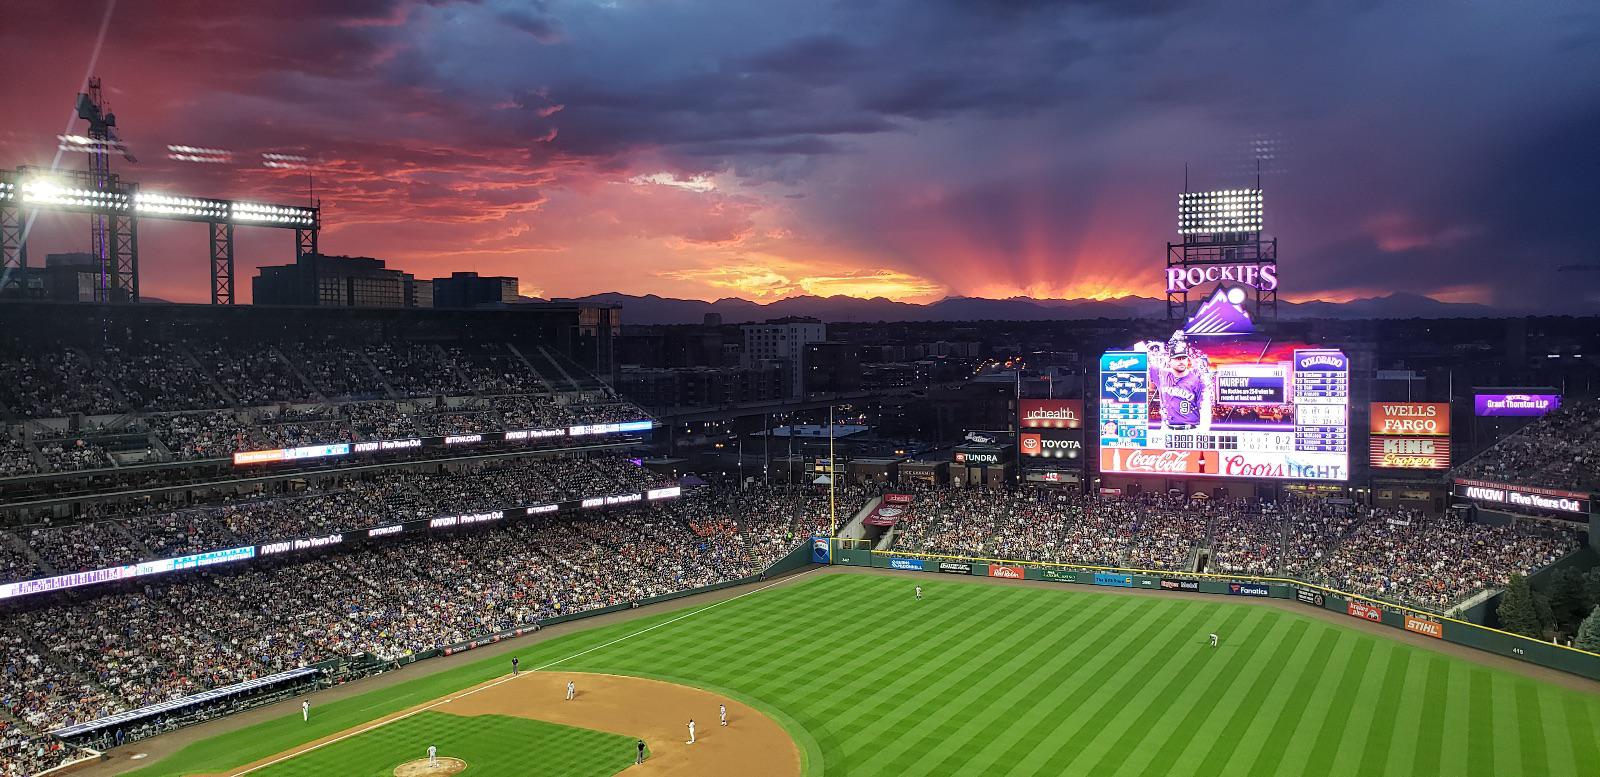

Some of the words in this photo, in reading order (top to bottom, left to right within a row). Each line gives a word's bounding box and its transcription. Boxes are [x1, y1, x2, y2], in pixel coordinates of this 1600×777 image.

[1165, 264, 1277, 292] ROCKIES
[1300, 354, 1342, 367] COLORADO
[1220, 377, 1248, 388] MURPHY
[1180, 400, 1190, 414] 9
[1488, 400, 1505, 408] Grant
[1506, 400, 1534, 408] Thornton
[1536, 400, 1548, 408] LLP
[1027, 406, 1074, 419] uchealth
[1383, 405, 1436, 417] WELLS
[1384, 419, 1436, 431] FARGO
[410, 438, 422, 447] Out
[1041, 440, 1081, 449] TOYOTA
[1384, 438, 1435, 454] KING
[964, 454, 998, 462] TUNDRA
[1383, 454, 1436, 467] Soopers
[1224, 455, 1286, 477] Coors
[1286, 464, 1341, 478] LIGHT
[1466, 486, 1504, 500] ARROW
[1510, 492, 1531, 504] Five
[1530, 494, 1558, 508] Years
[1560, 498, 1580, 512] Out
[474, 513, 491, 522] Years
[491, 510, 504, 519] Out
[368, 524, 402, 536] arrow.com
[295, 540, 310, 550] Five
[310, 537, 329, 547] Years
[329, 534, 342, 544] Out
[1004, 570, 1019, 578] Robin
[1240, 586, 1268, 595] Fanatics
[1408, 619, 1438, 635] STIHL
